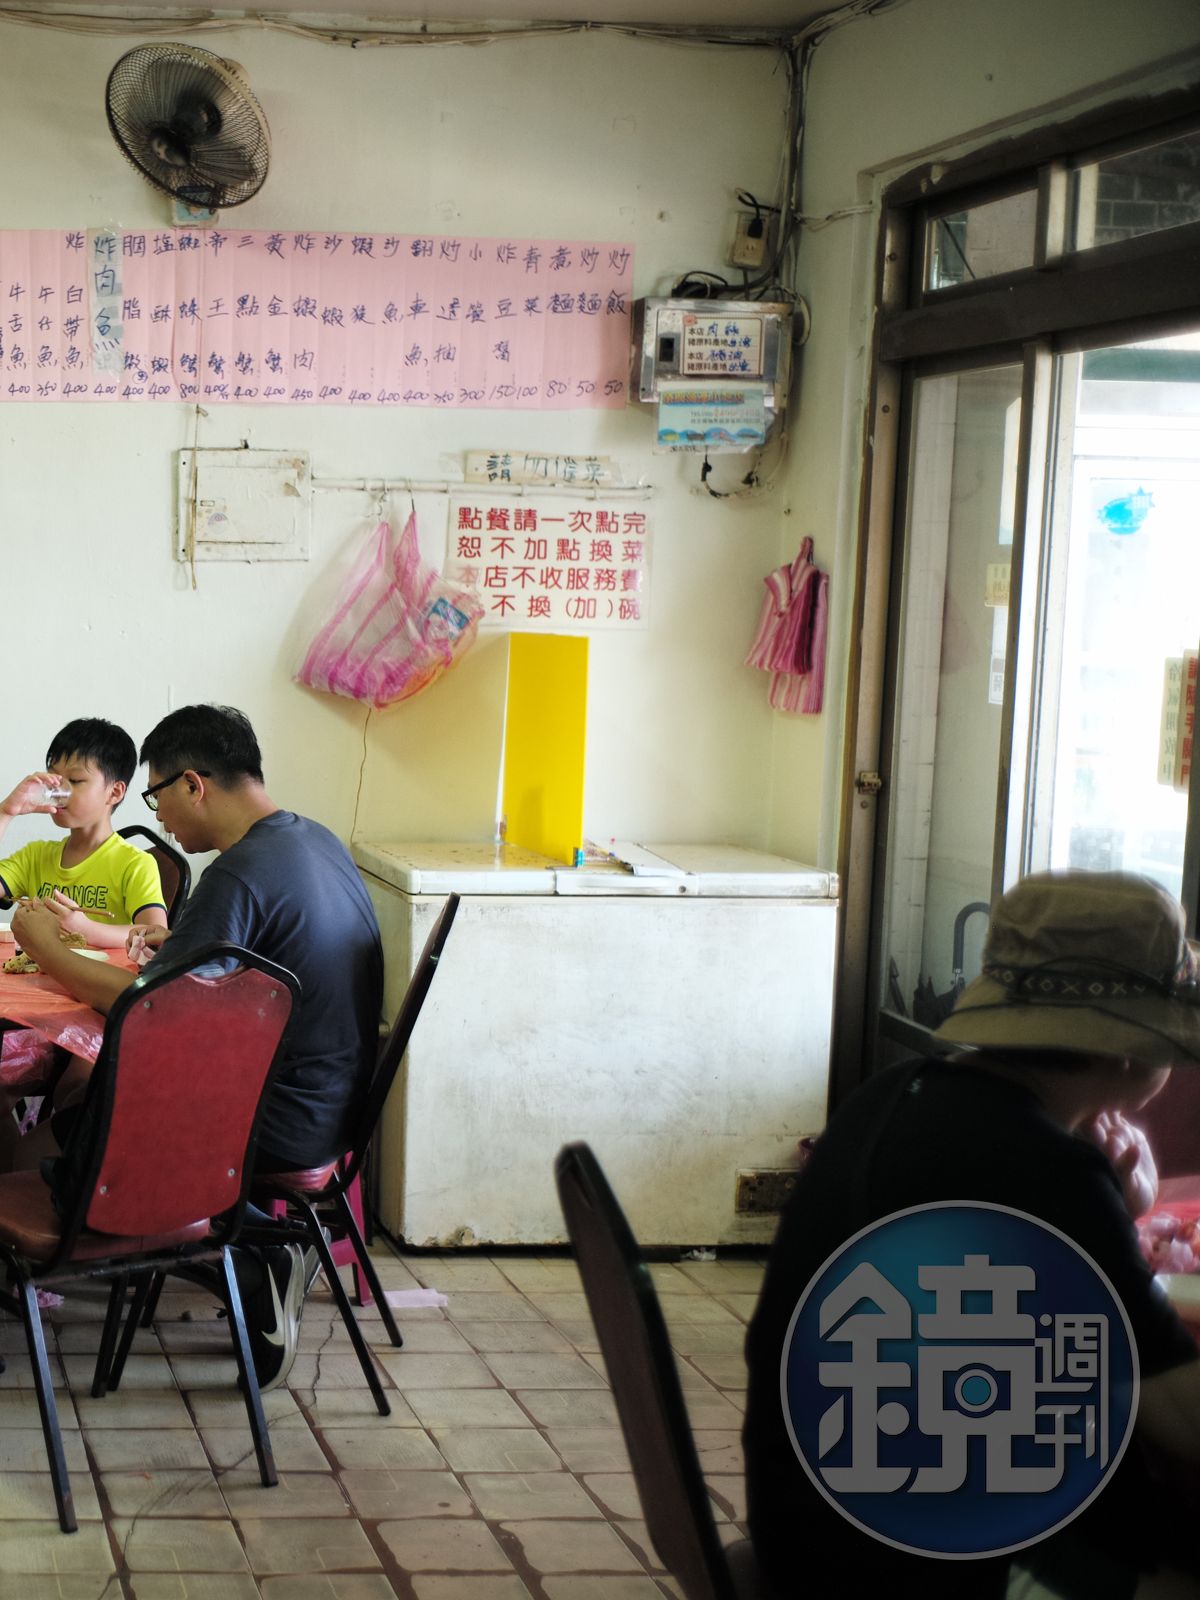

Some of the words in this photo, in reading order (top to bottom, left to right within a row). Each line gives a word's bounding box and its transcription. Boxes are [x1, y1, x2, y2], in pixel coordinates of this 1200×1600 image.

[8, 382, 31, 397] 400
[63, 382, 88, 398] 400
[122, 385, 144, 400] 400
[148, 382, 171, 399] 400
[263, 386, 286, 398] 400
[319, 385, 342, 399] 400
[459, 388, 485, 403] 300
[488, 383, 515, 400] 150
[516, 385, 538, 399] 100
[546, 380, 567, 397] 80
[576, 380, 595, 395] 50
[604, 380, 623, 396] 50
[348, 390, 371, 402] 400
[457, 506, 647, 534] 點餐請一次點完
[457, 536, 645, 563] 恕不加點換菜
[456, 564, 642, 593] 本店不收服務費
[491, 595, 641, 621] 不換(加)碗
